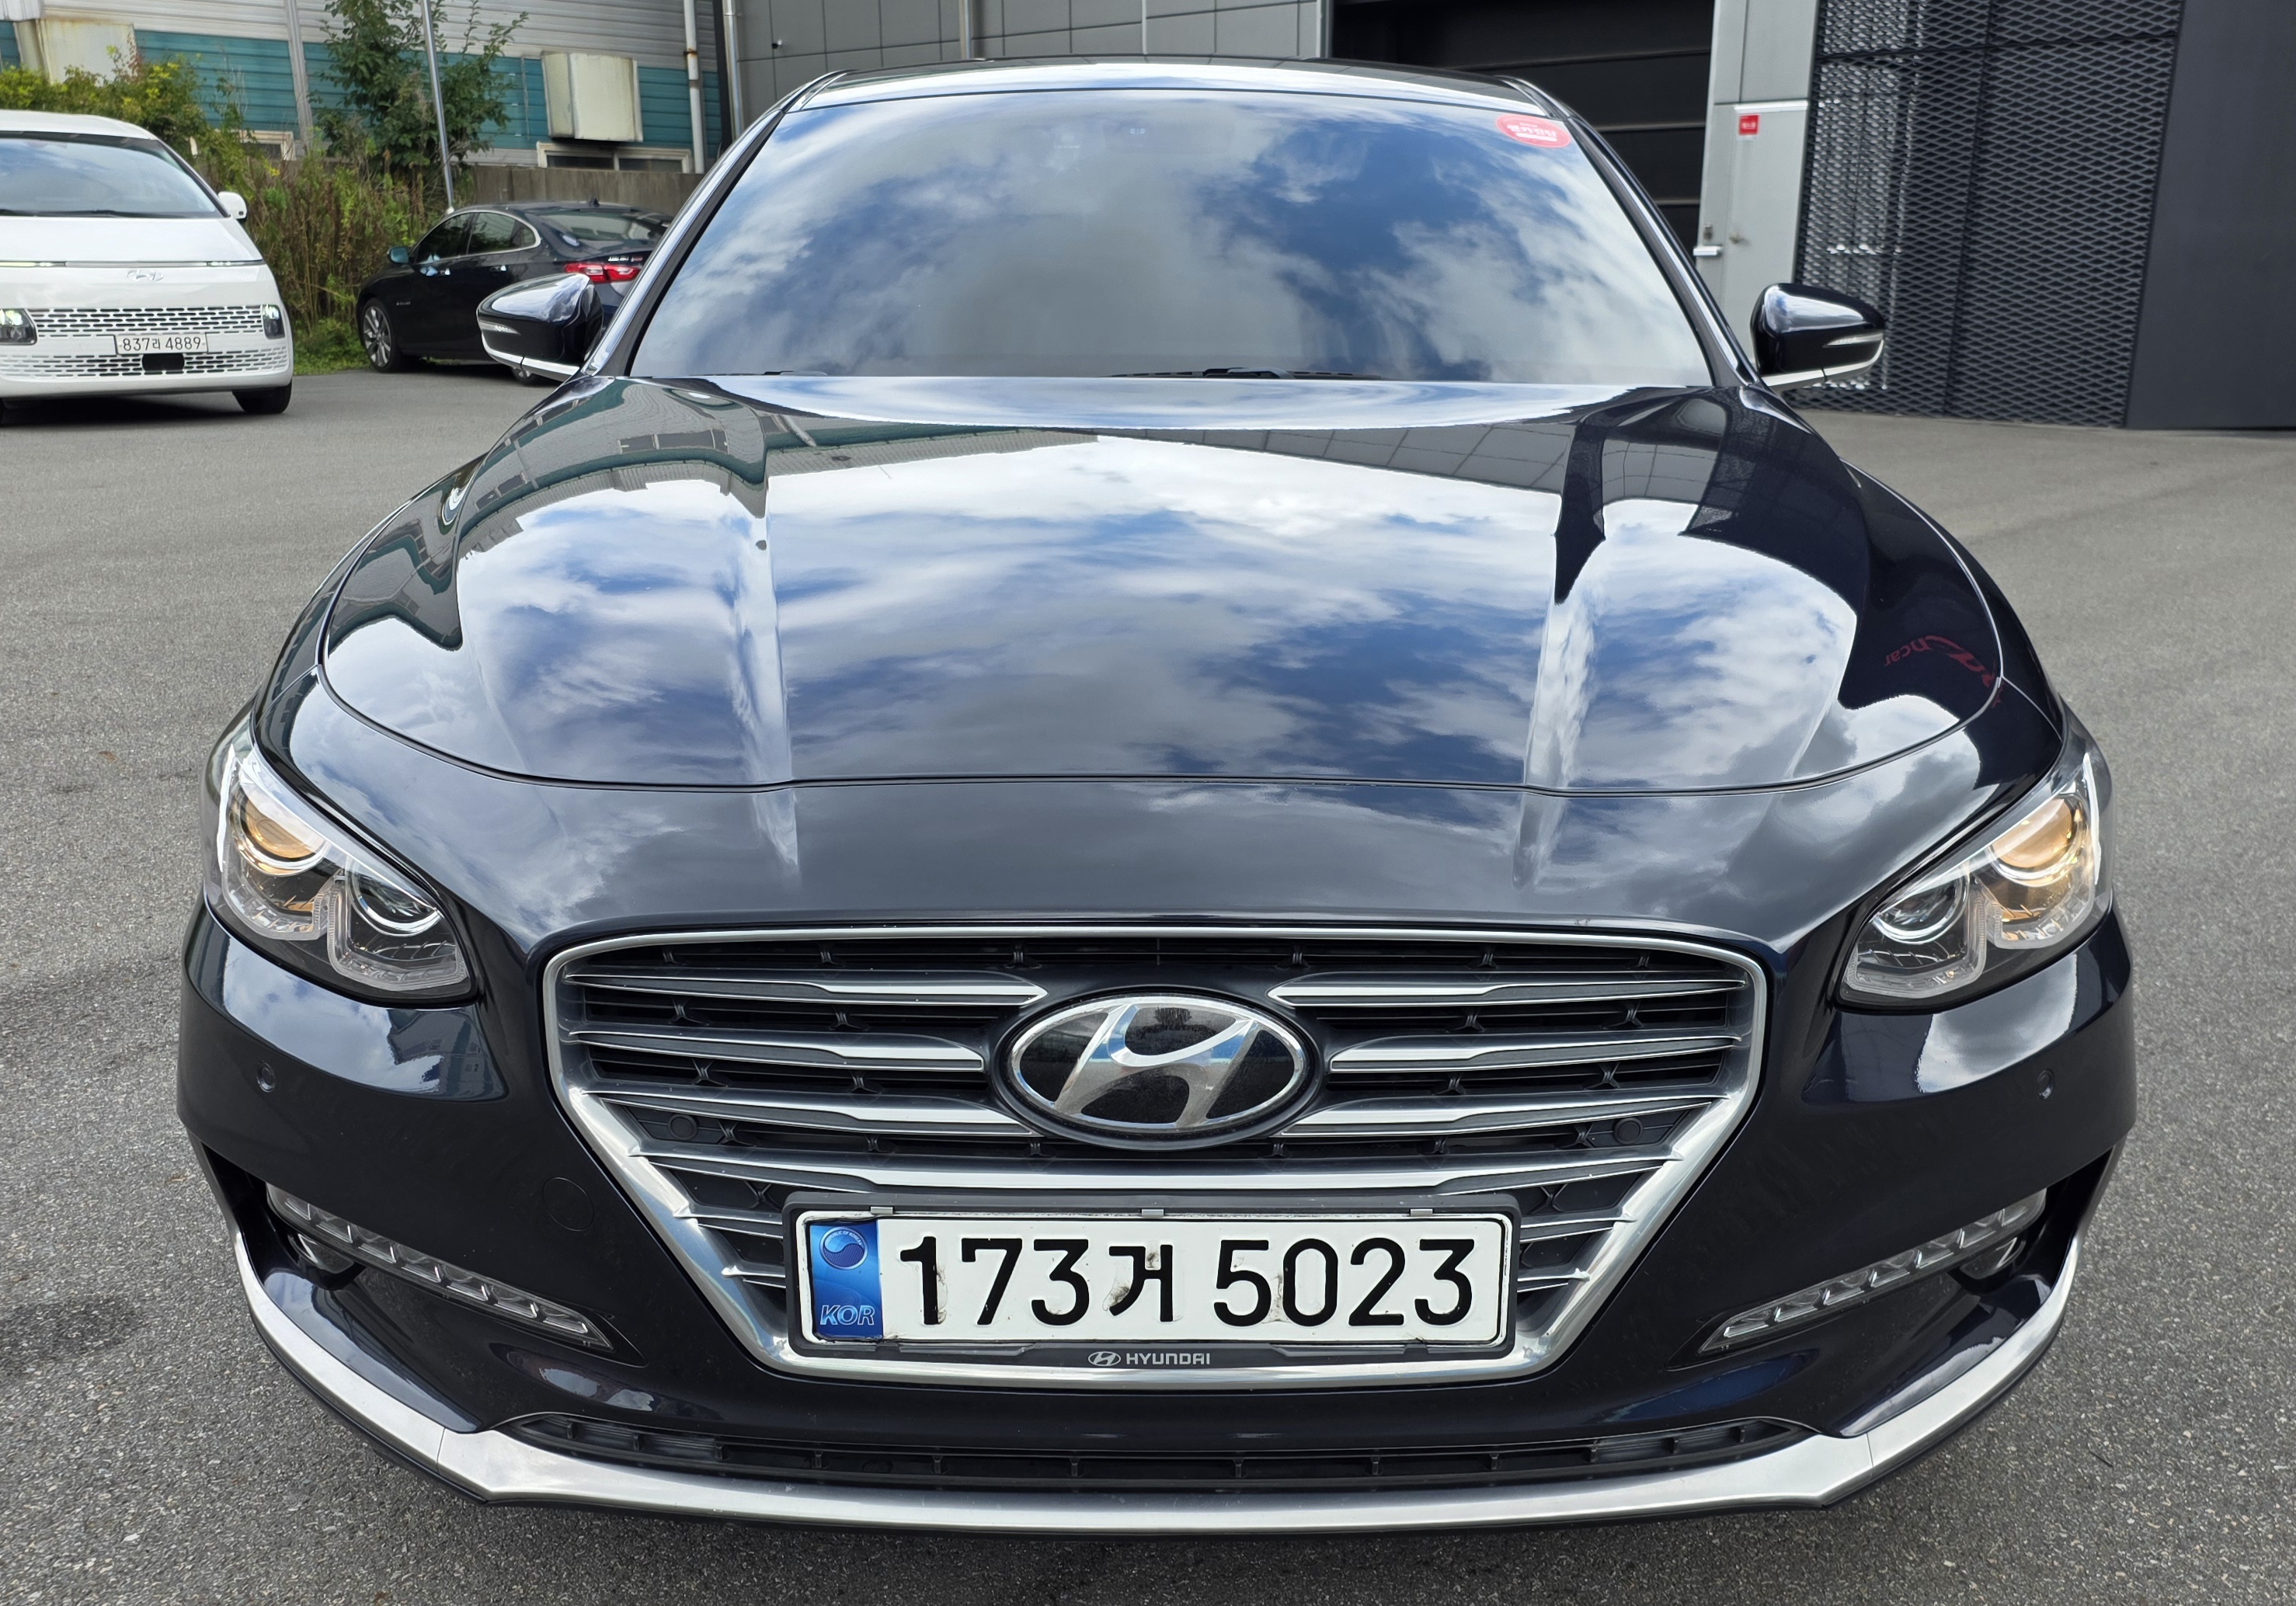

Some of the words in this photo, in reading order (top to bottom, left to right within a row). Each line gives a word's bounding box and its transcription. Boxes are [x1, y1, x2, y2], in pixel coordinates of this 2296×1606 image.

[165, 337, 201, 349] 4889
[899, 1236, 1174, 1326] 173거
[1213, 1237, 1475, 1326] 5023
[820, 1305, 875, 1326] KOR
[1125, 1353, 1210, 1365] HYUNDAI
